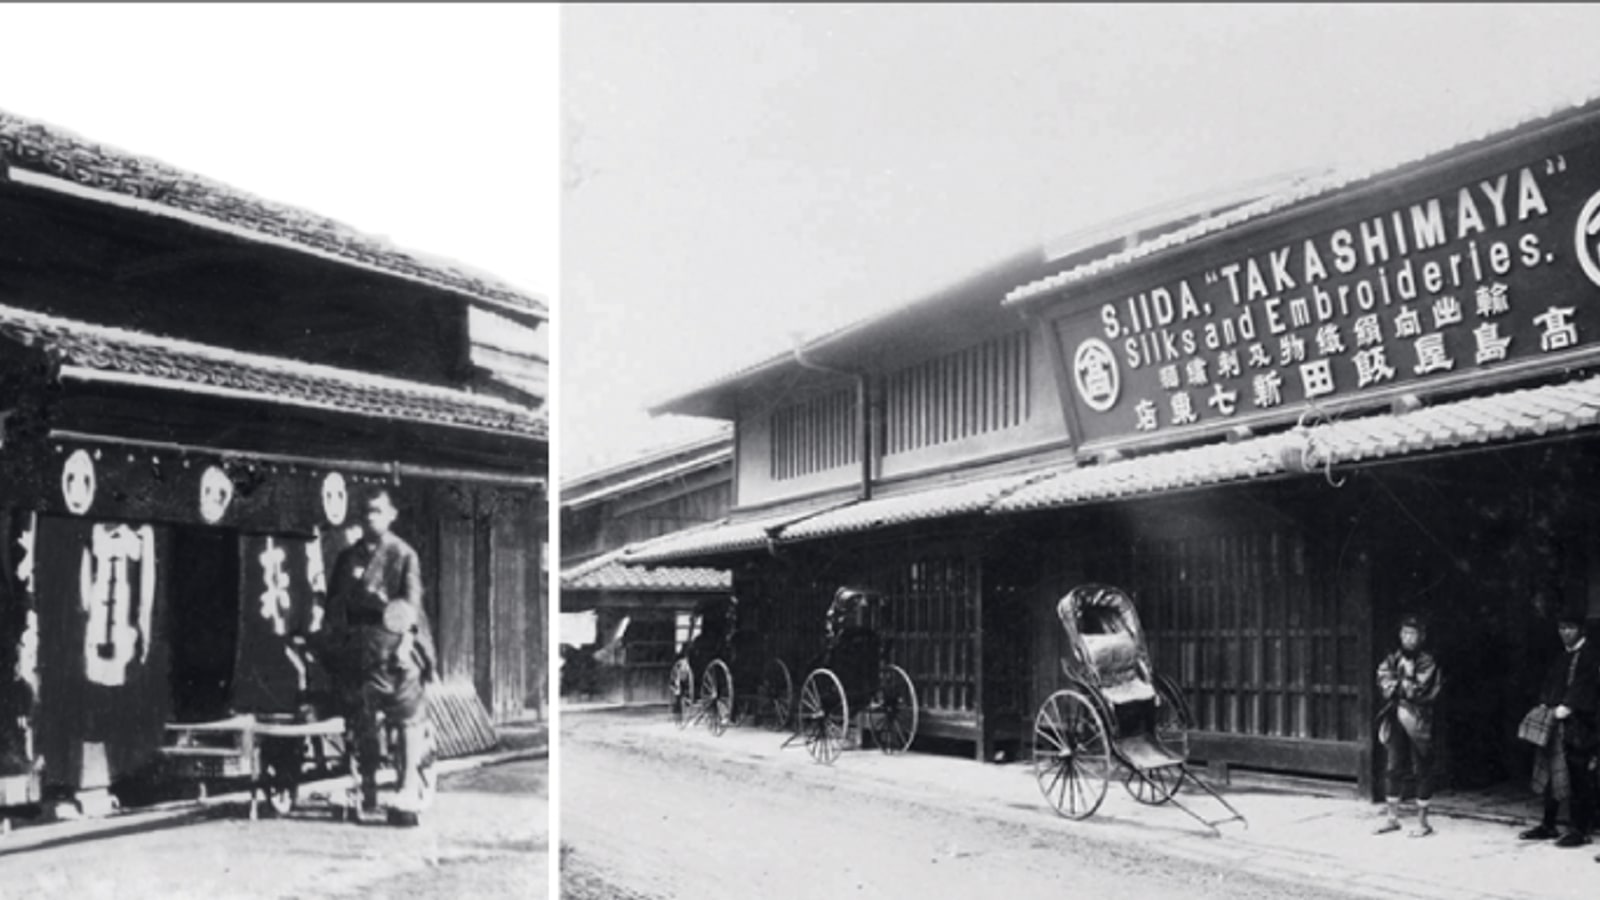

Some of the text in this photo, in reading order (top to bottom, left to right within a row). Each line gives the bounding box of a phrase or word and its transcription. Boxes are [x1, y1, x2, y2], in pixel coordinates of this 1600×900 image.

[1124, 329, 1197, 369] Silks
[1204, 305, 1256, 350] and
[1265, 233, 1554, 335] Embroideries.
